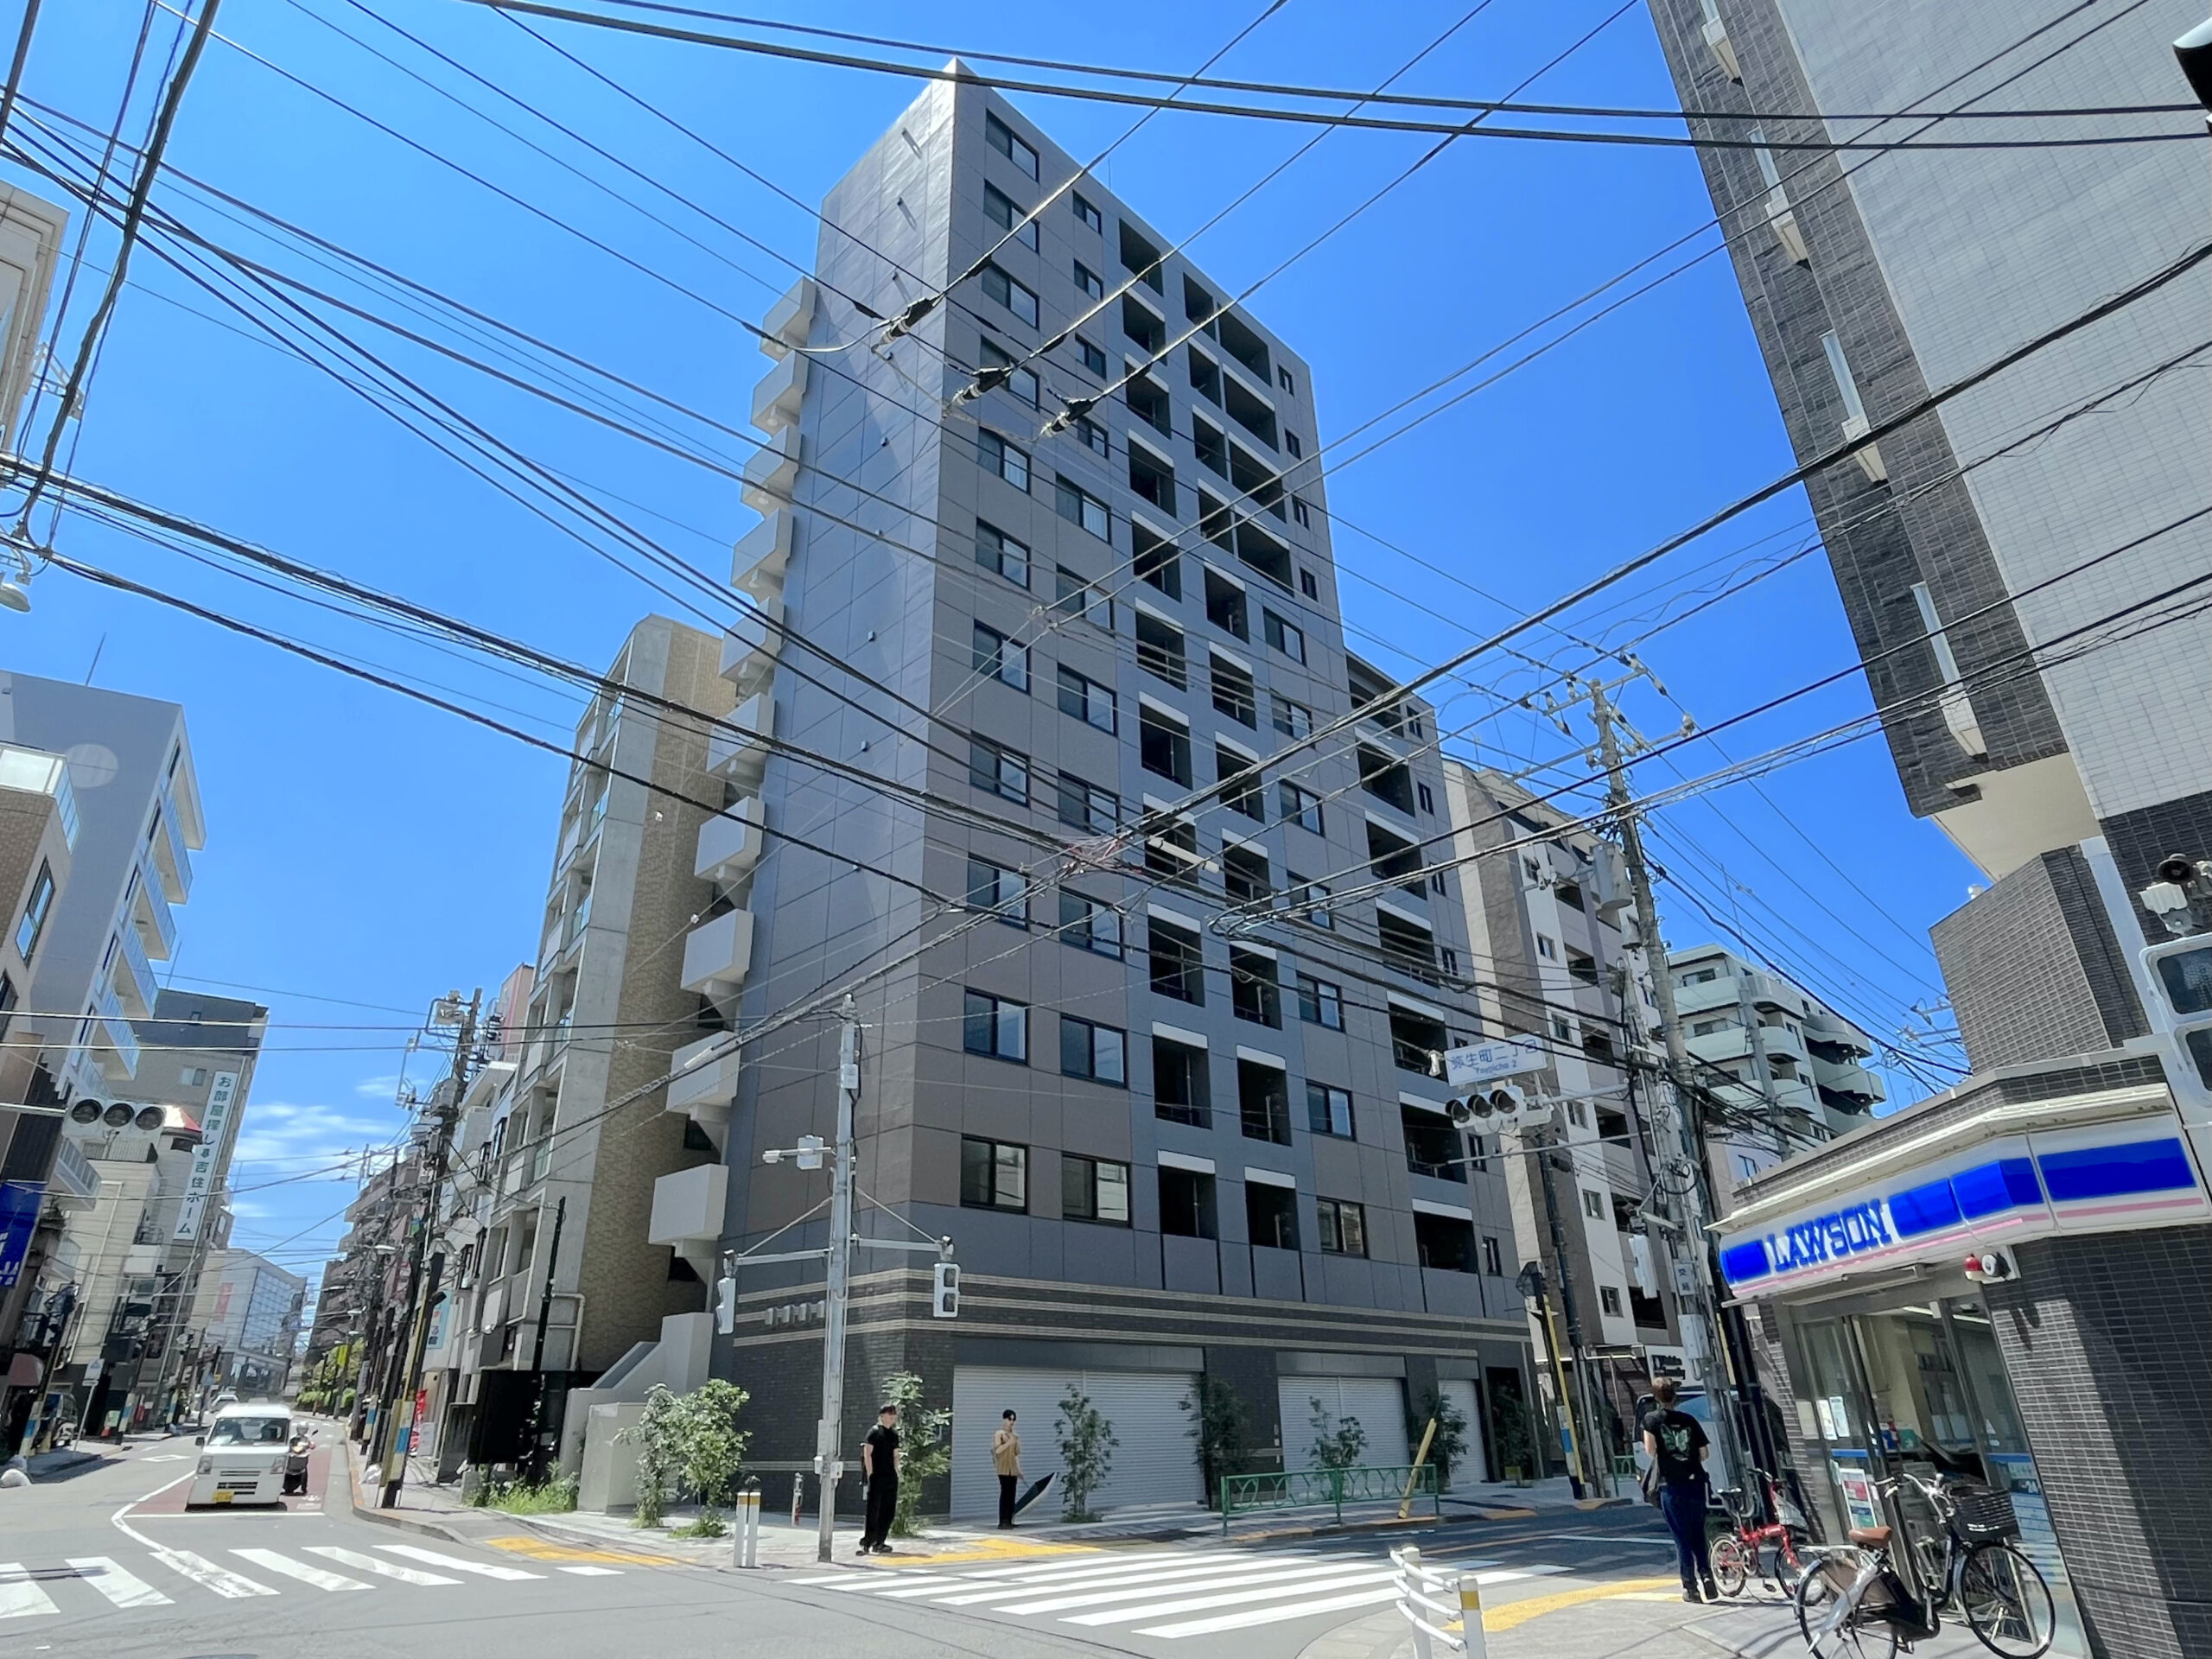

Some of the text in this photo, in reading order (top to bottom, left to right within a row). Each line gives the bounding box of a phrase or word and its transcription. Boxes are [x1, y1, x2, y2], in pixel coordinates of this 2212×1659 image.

[1452, 1039, 1538, 1070] 弥生町二丁目
[1511, 1059, 1518, 1068] 2
[1767, 1198, 1891, 1272] LAWSON
